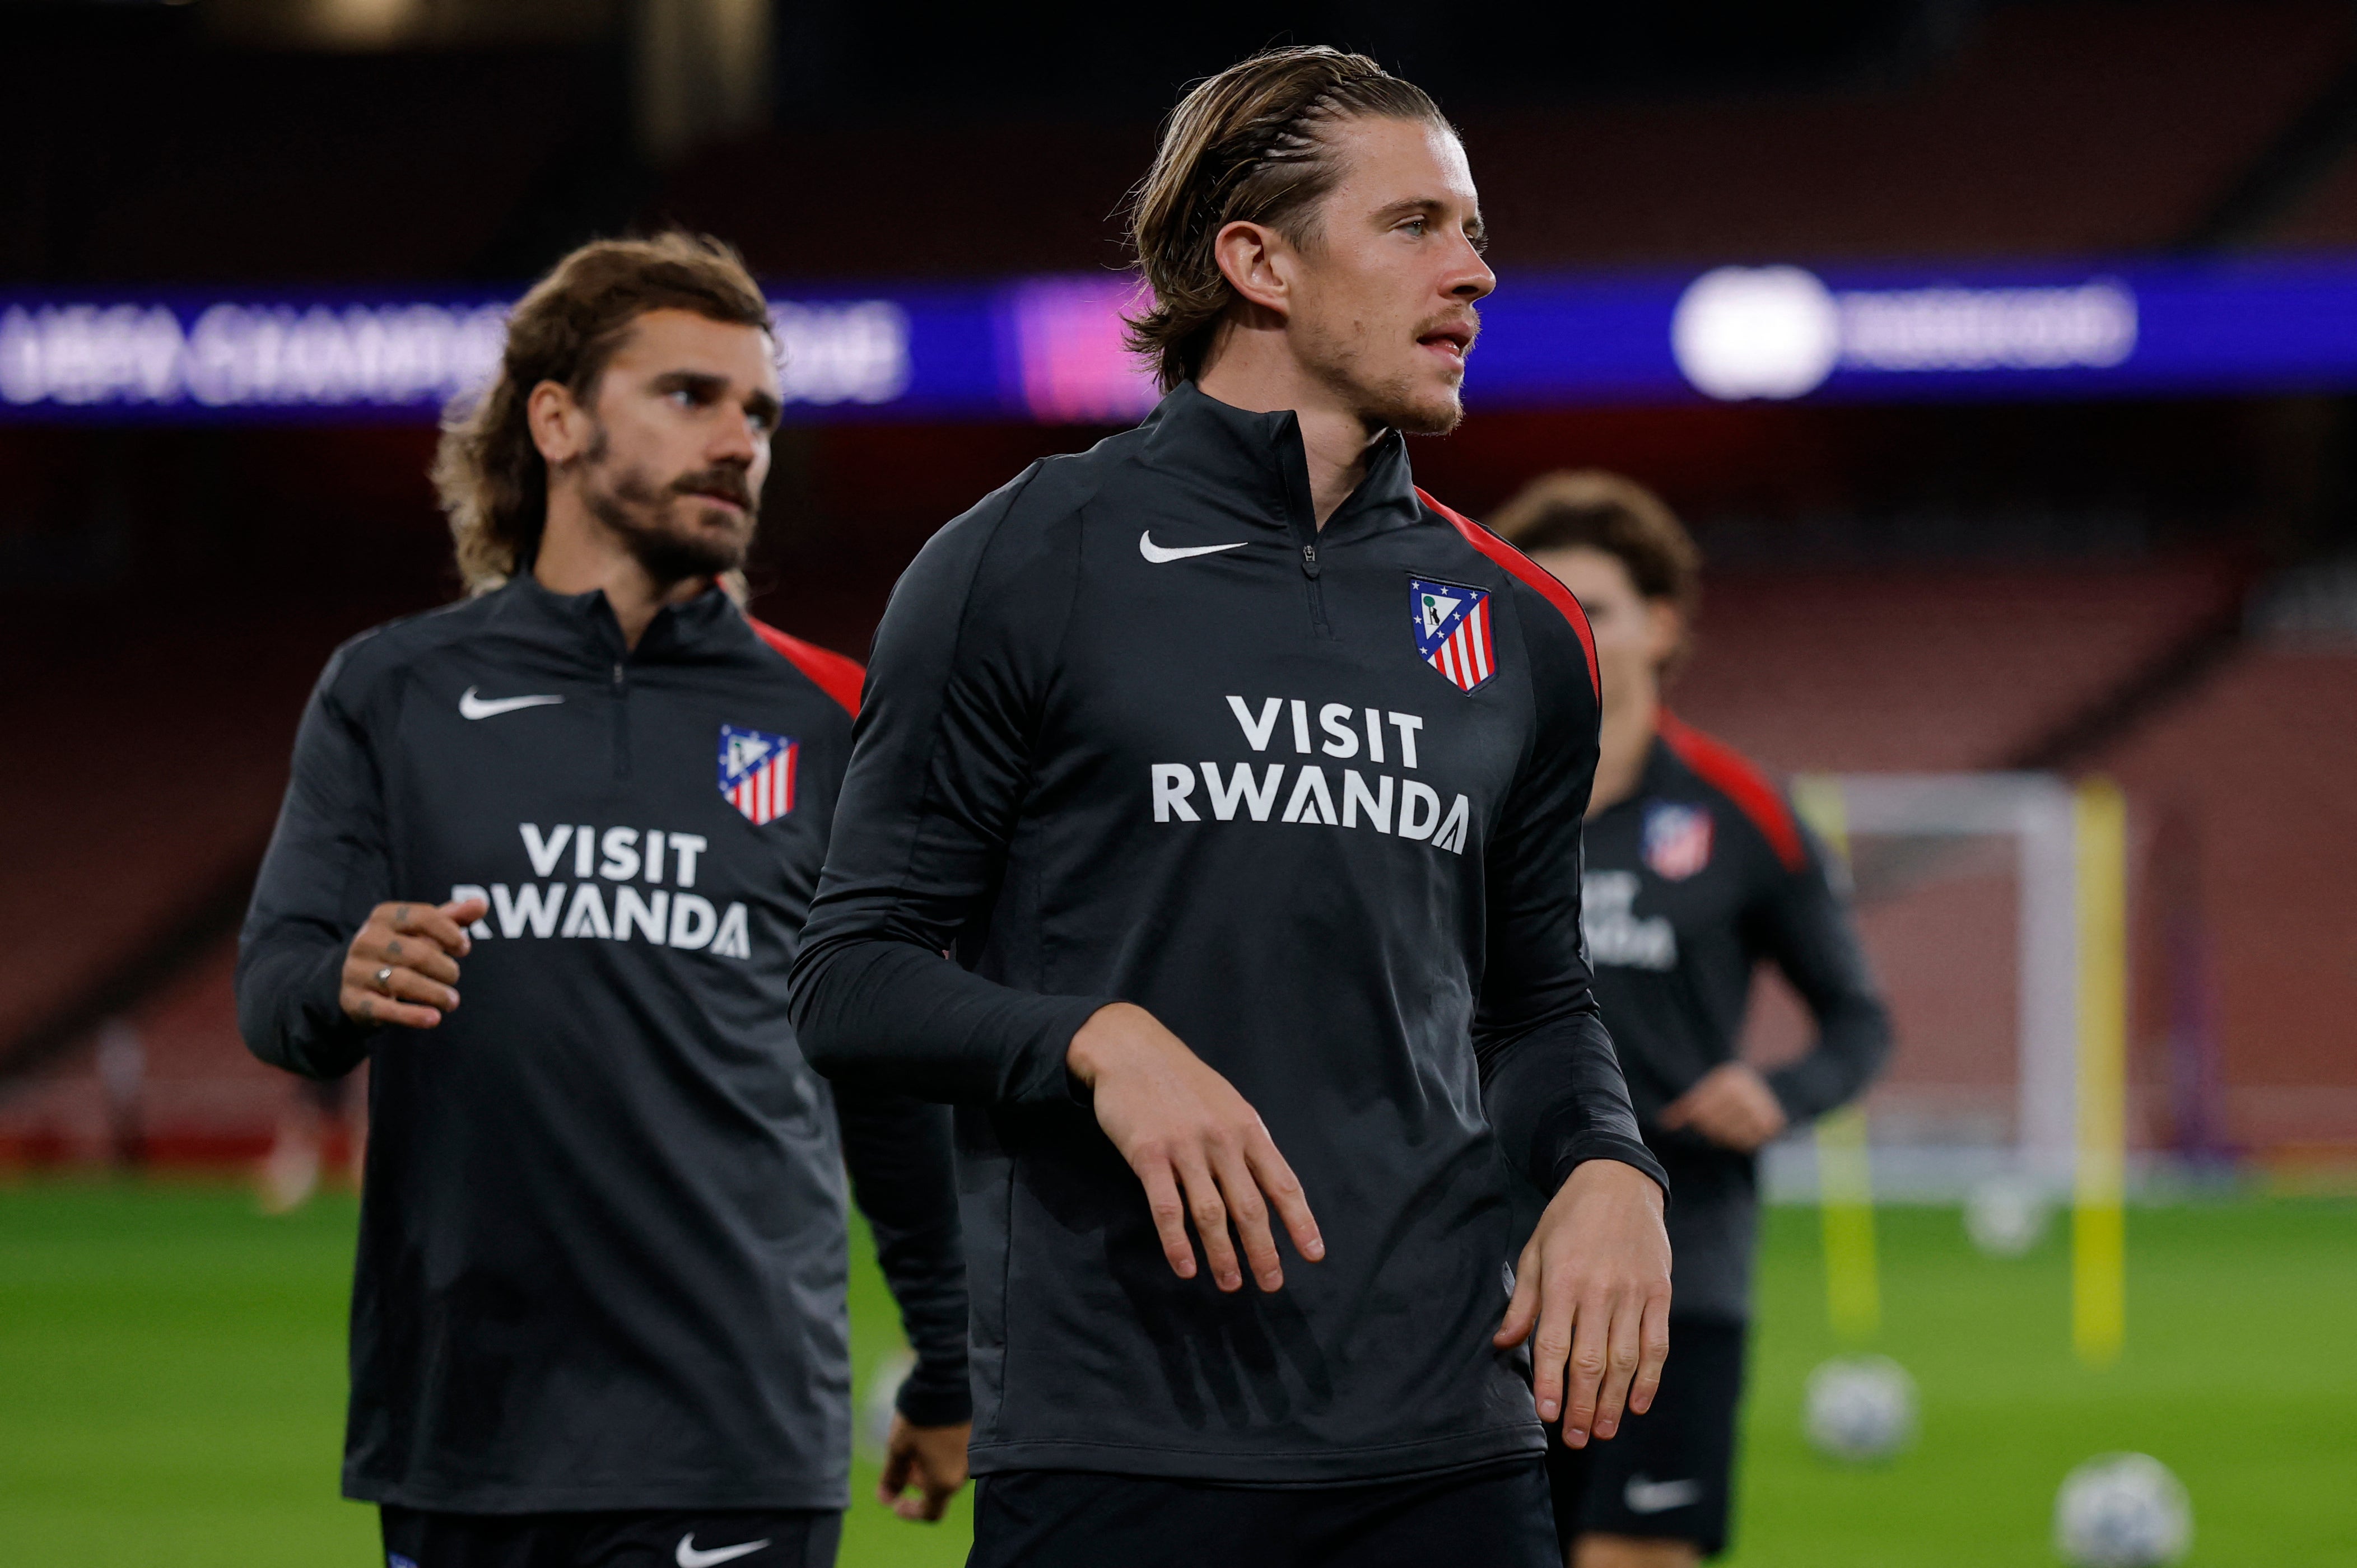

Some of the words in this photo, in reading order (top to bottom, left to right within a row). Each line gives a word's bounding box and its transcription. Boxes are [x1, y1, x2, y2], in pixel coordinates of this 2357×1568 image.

[1226, 696, 1423, 768] VISIT
[1152, 762, 1469, 855] RWANDA
[519, 823, 707, 888] VISIT
